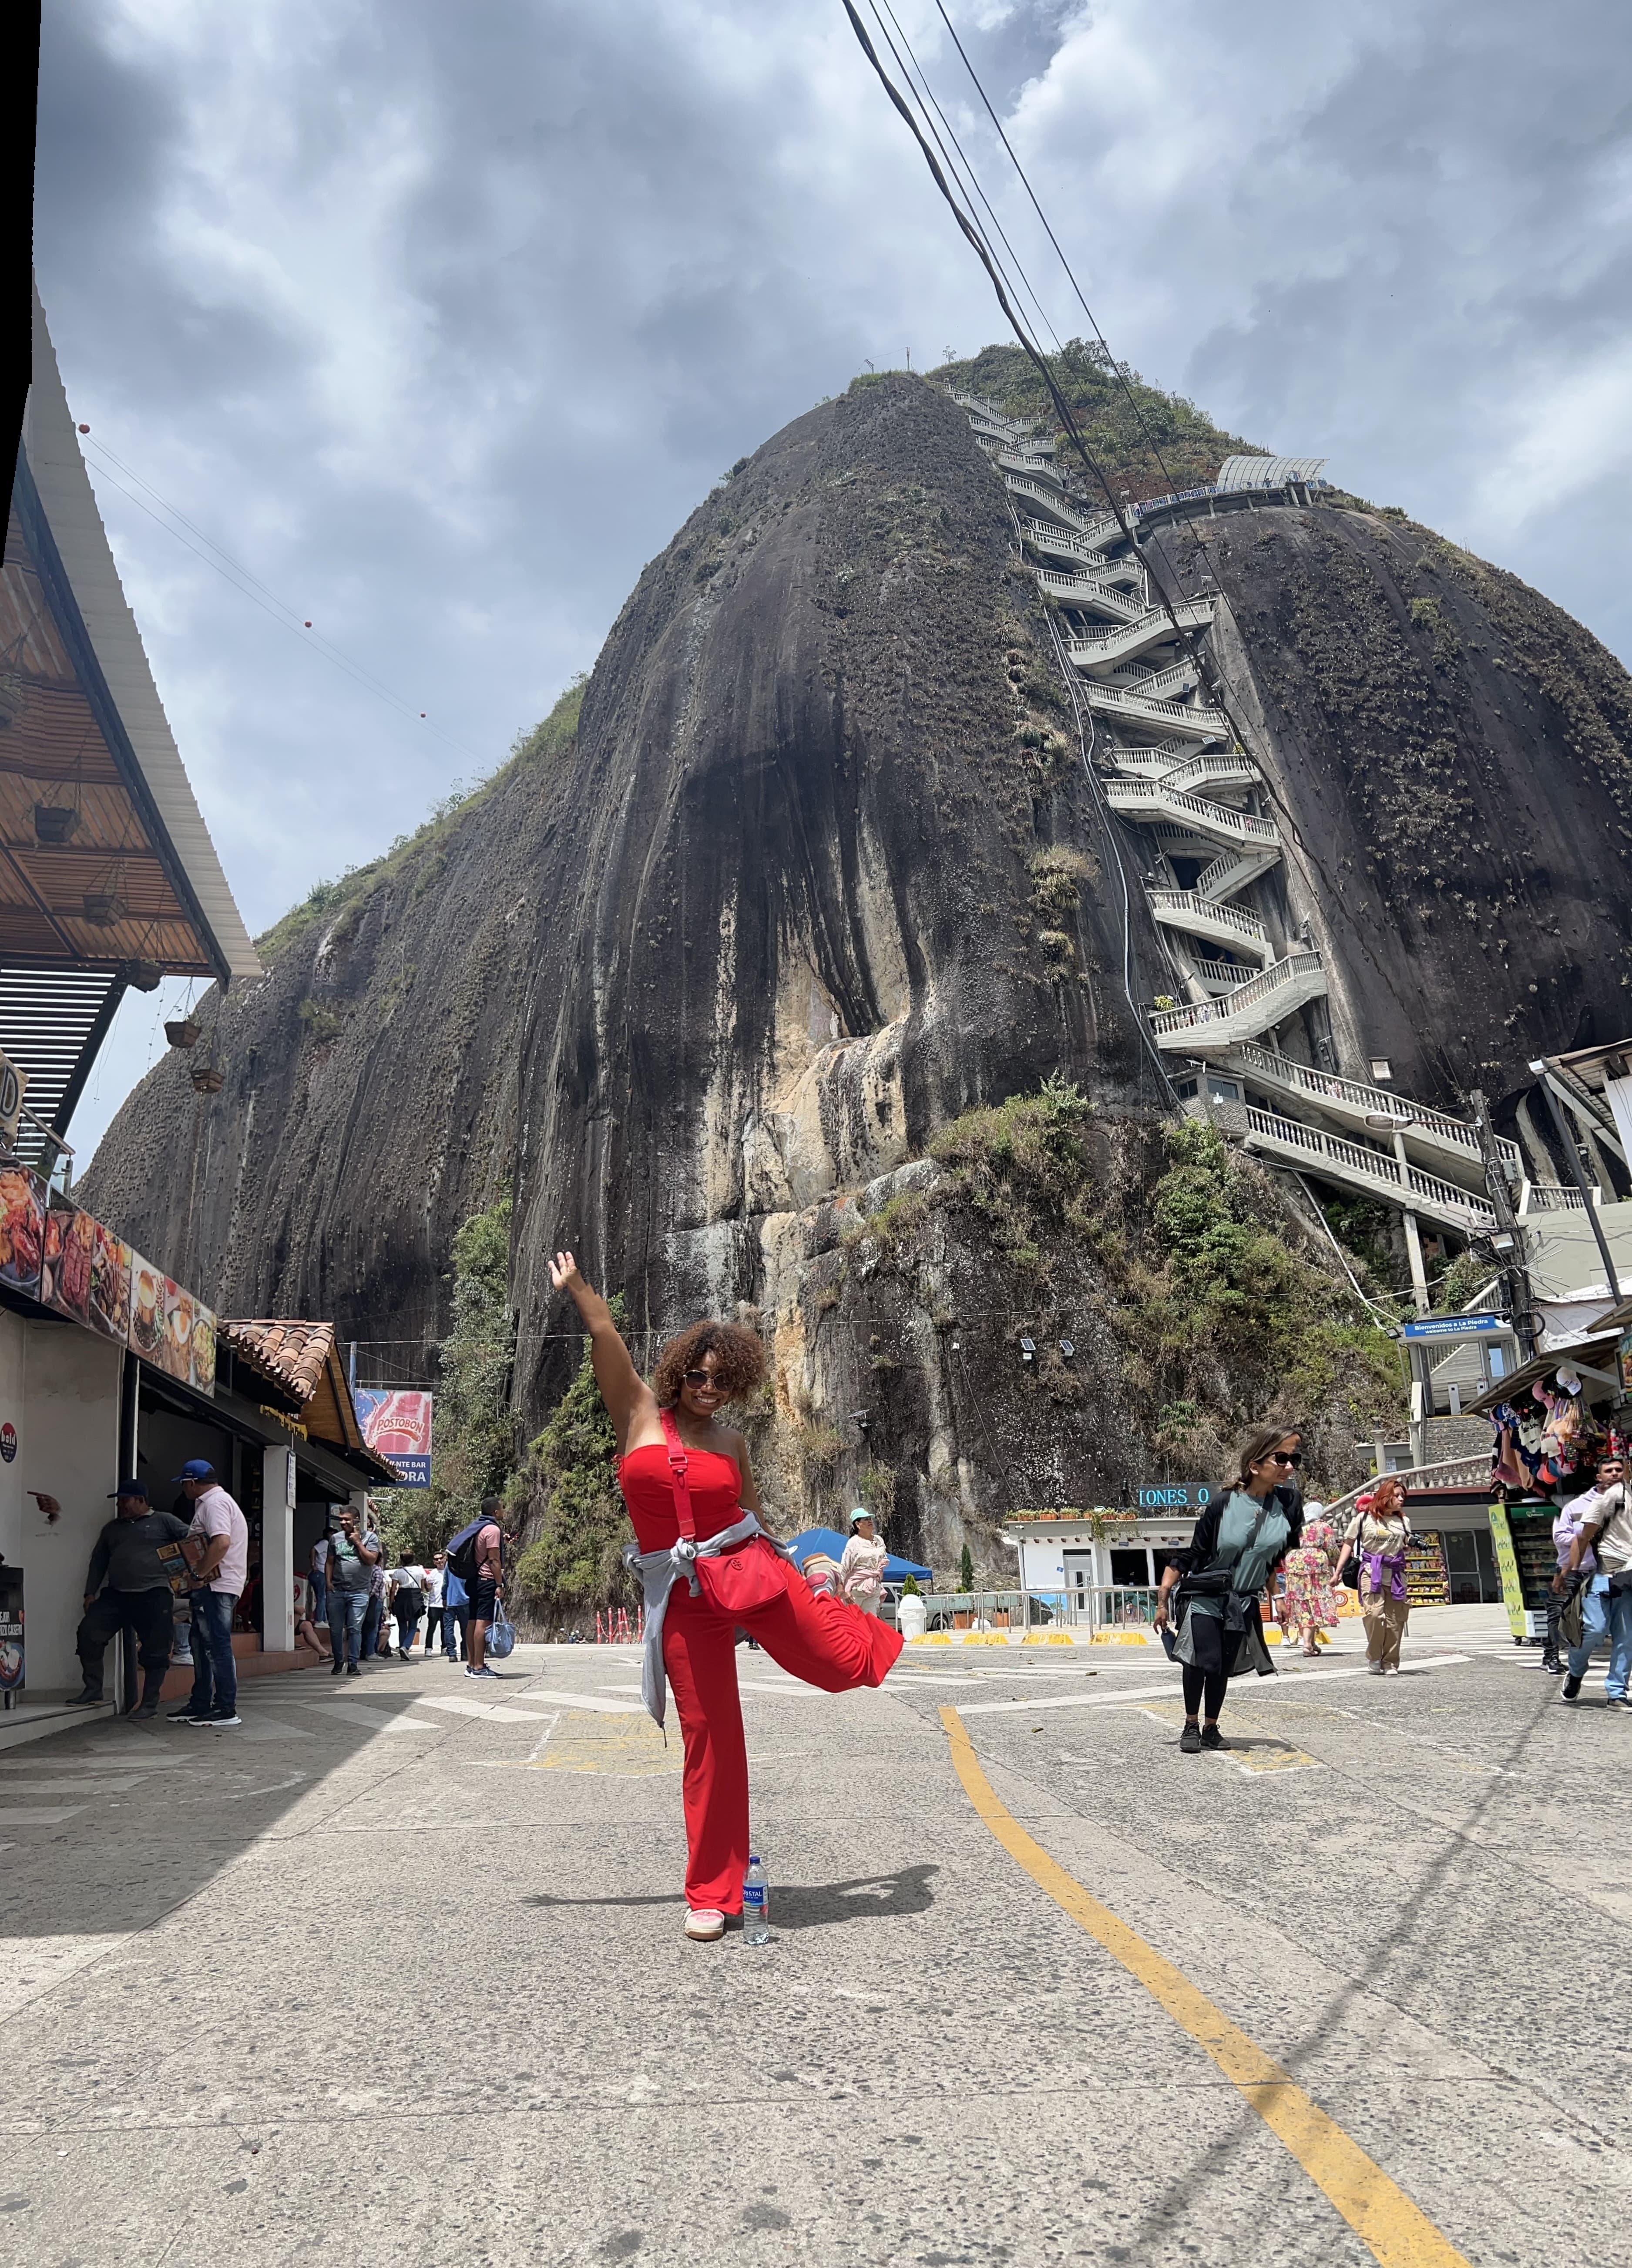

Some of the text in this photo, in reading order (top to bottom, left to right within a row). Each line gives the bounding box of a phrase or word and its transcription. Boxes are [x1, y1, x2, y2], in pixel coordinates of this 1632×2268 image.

[1414, 1322, 1452, 1331] Bienvenidos
[377, 1418, 423, 1433] POSTOBON
[8, 1624, 23, 1635] CASERO
